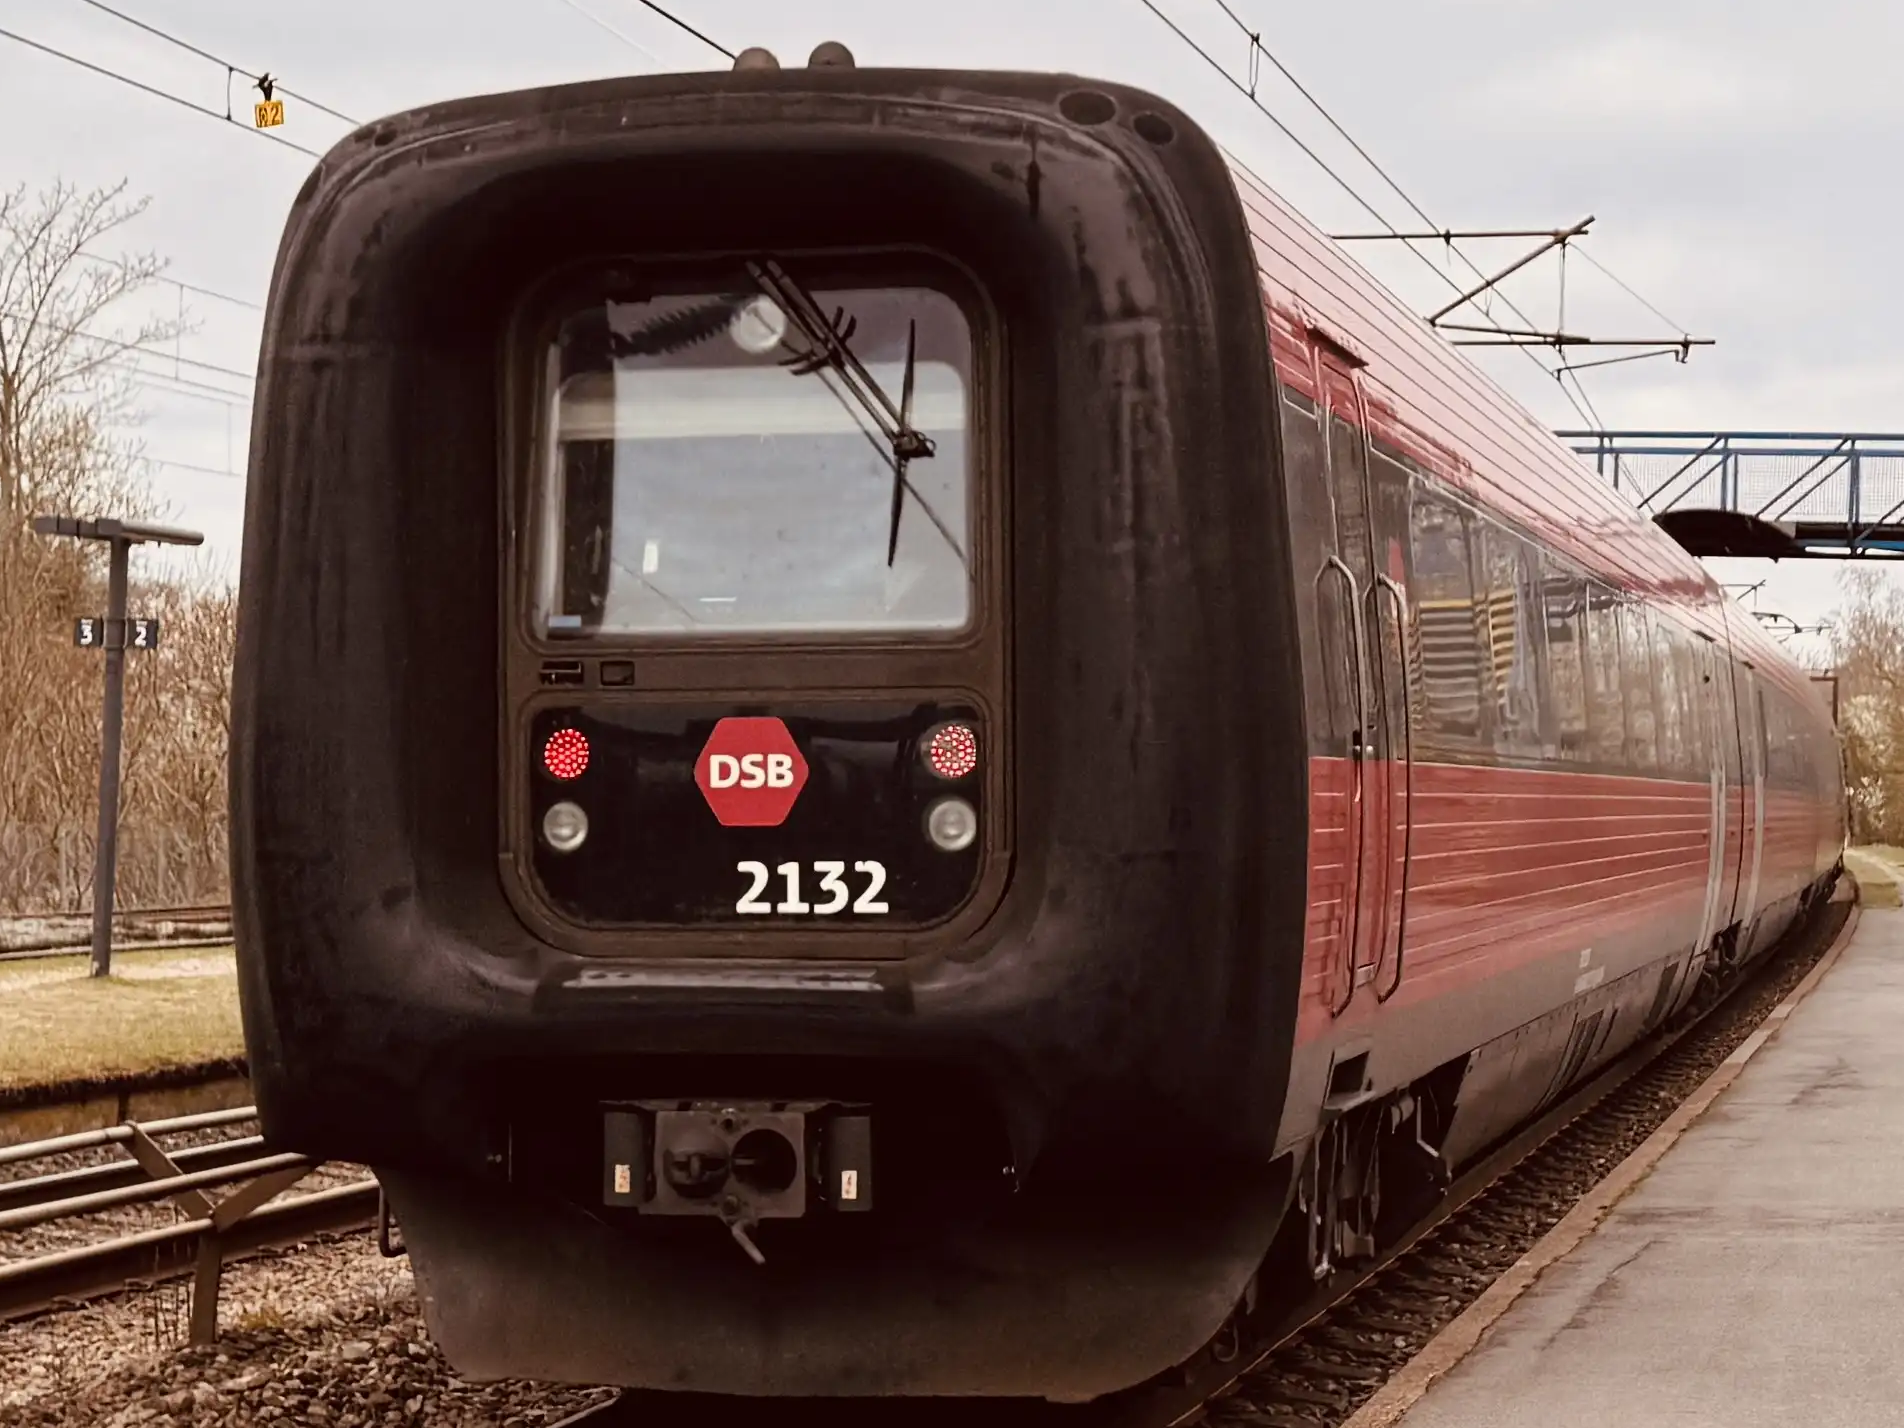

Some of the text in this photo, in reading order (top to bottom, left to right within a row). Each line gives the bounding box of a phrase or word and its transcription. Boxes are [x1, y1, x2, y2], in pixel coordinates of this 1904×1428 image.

[80, 624, 93, 645] 3
[134, 626, 147, 647] 2
[709, 753, 794, 789] DSB
[735, 860, 889, 915] 2132
